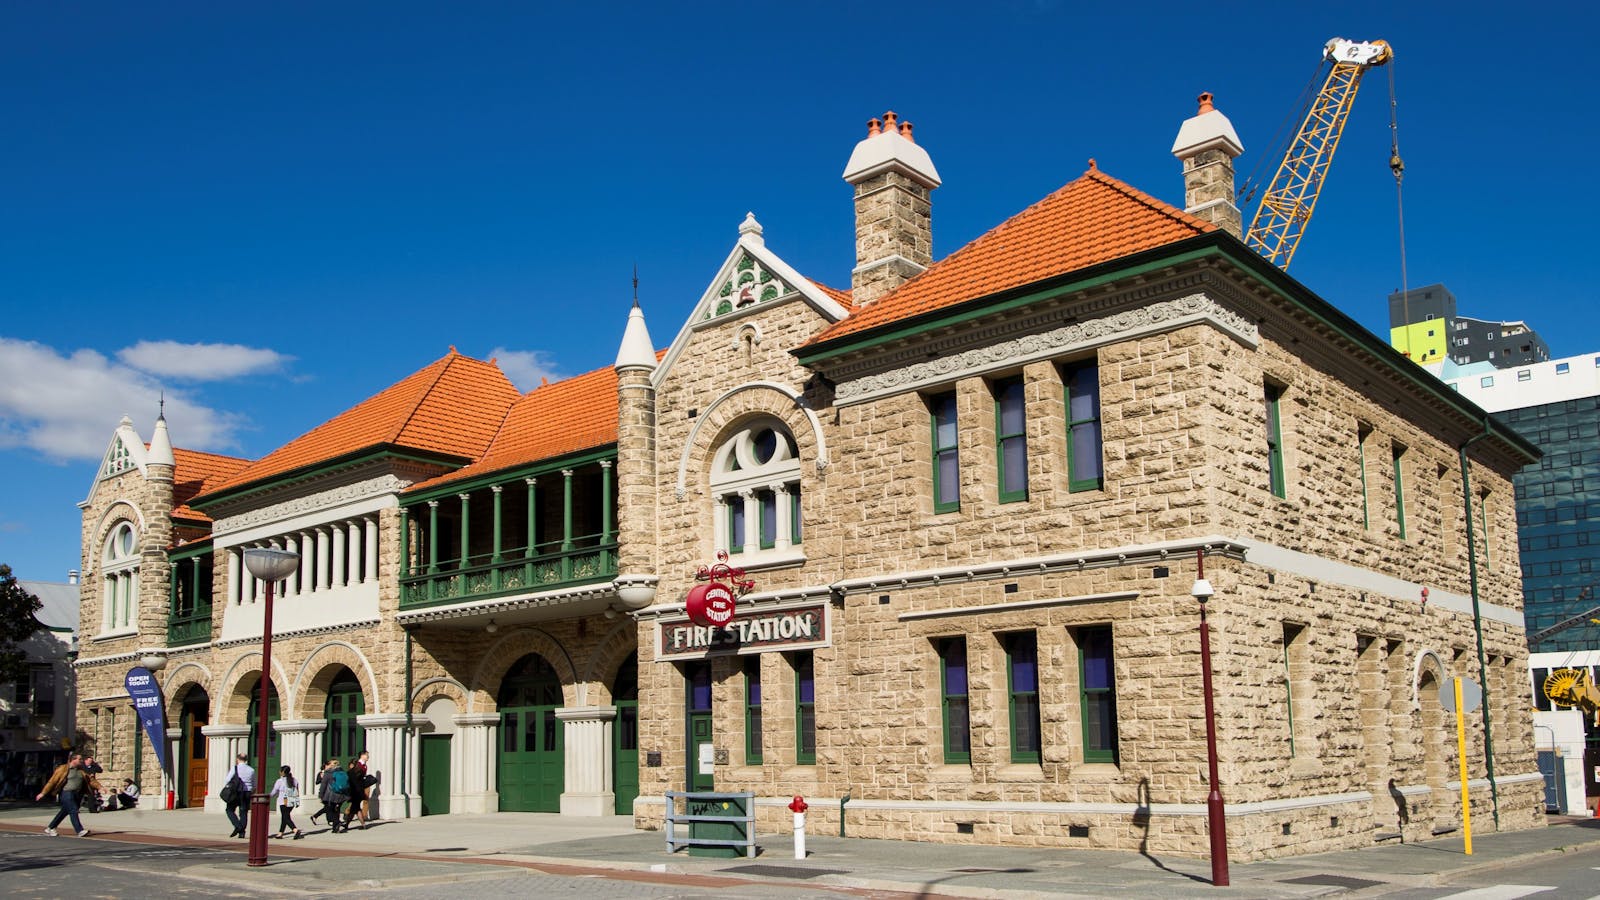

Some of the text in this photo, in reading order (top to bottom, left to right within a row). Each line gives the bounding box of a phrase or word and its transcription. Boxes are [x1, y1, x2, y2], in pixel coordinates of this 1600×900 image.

[706, 588, 732, 603] CENTRAL
[712, 601, 726, 609] FIRE
[706, 607, 732, 622] STATION
[674, 614, 812, 649] FIRE STATION
